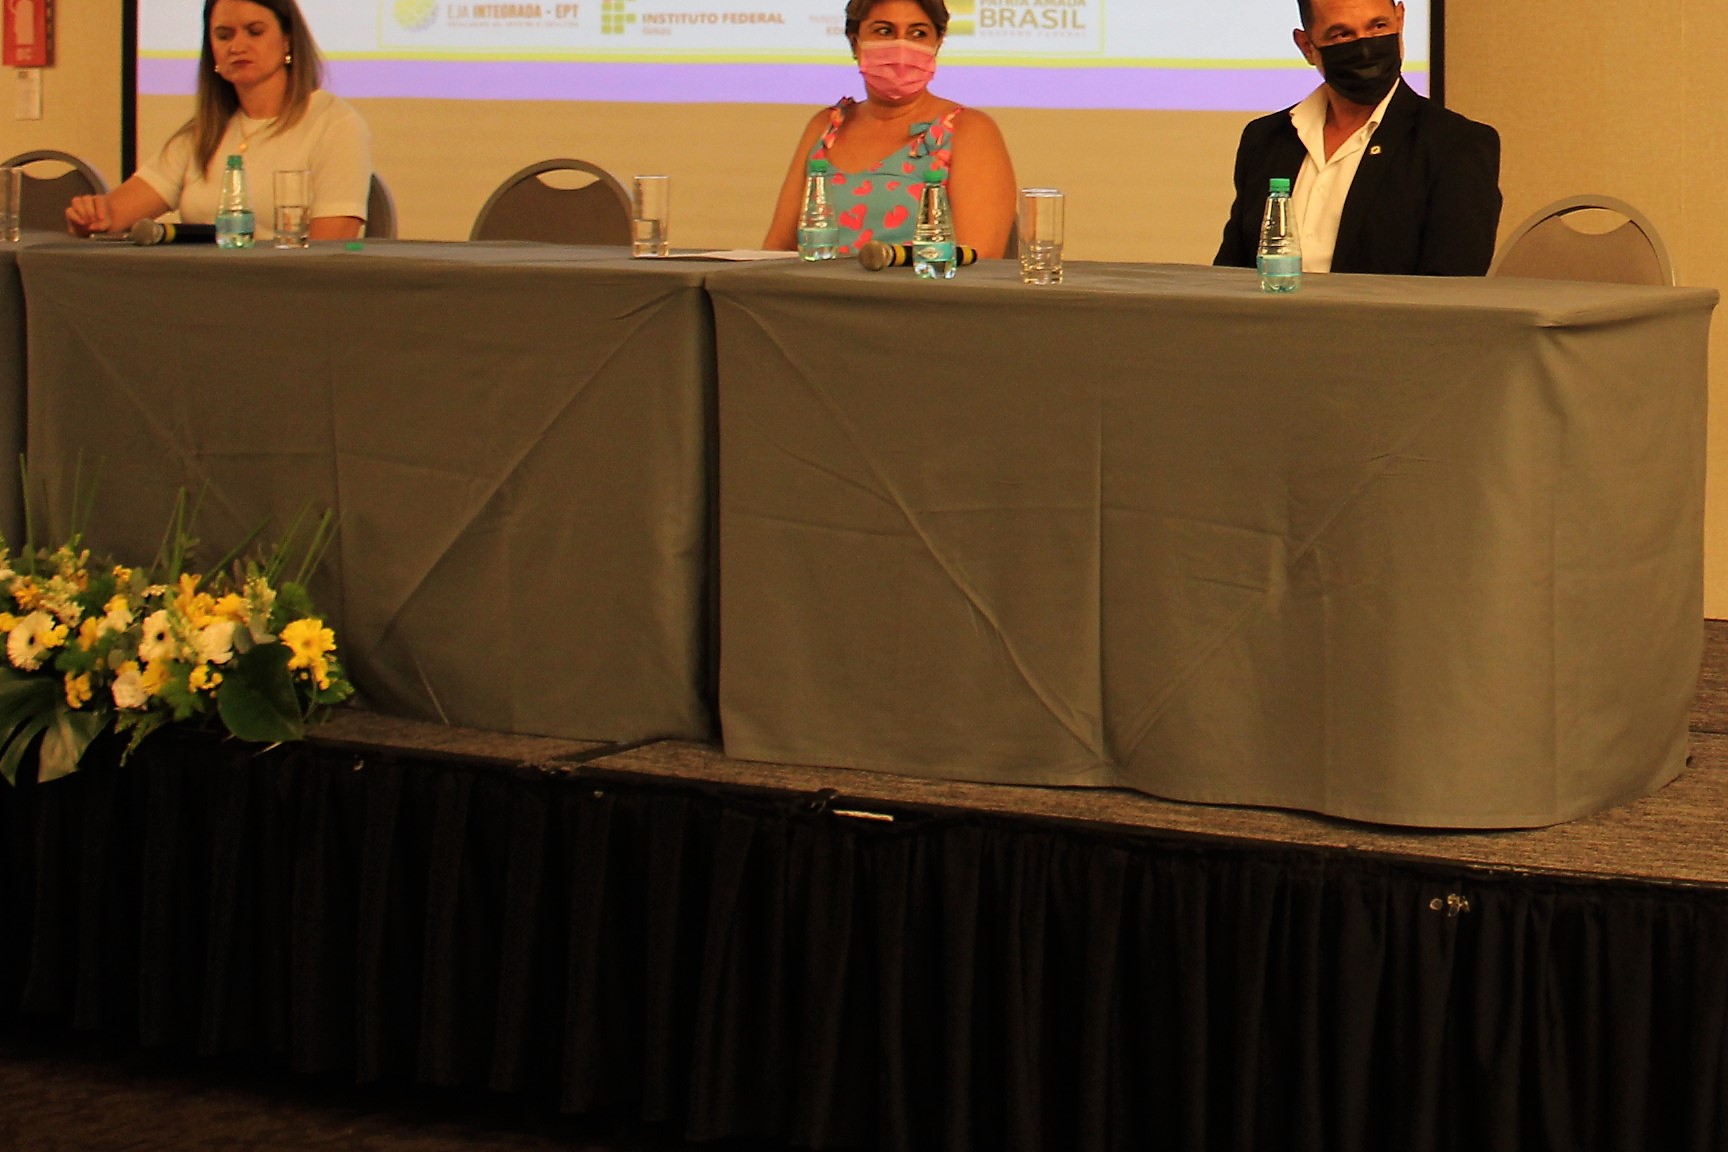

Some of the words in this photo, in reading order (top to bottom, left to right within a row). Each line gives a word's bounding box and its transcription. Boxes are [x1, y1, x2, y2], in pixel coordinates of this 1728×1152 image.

[555, 3, 579, 18] EPT
[980, 7, 1086, 29] BRASIL
[642, 13, 717, 24] INSTITUTO
[722, 13, 784, 24] FEDERAL
